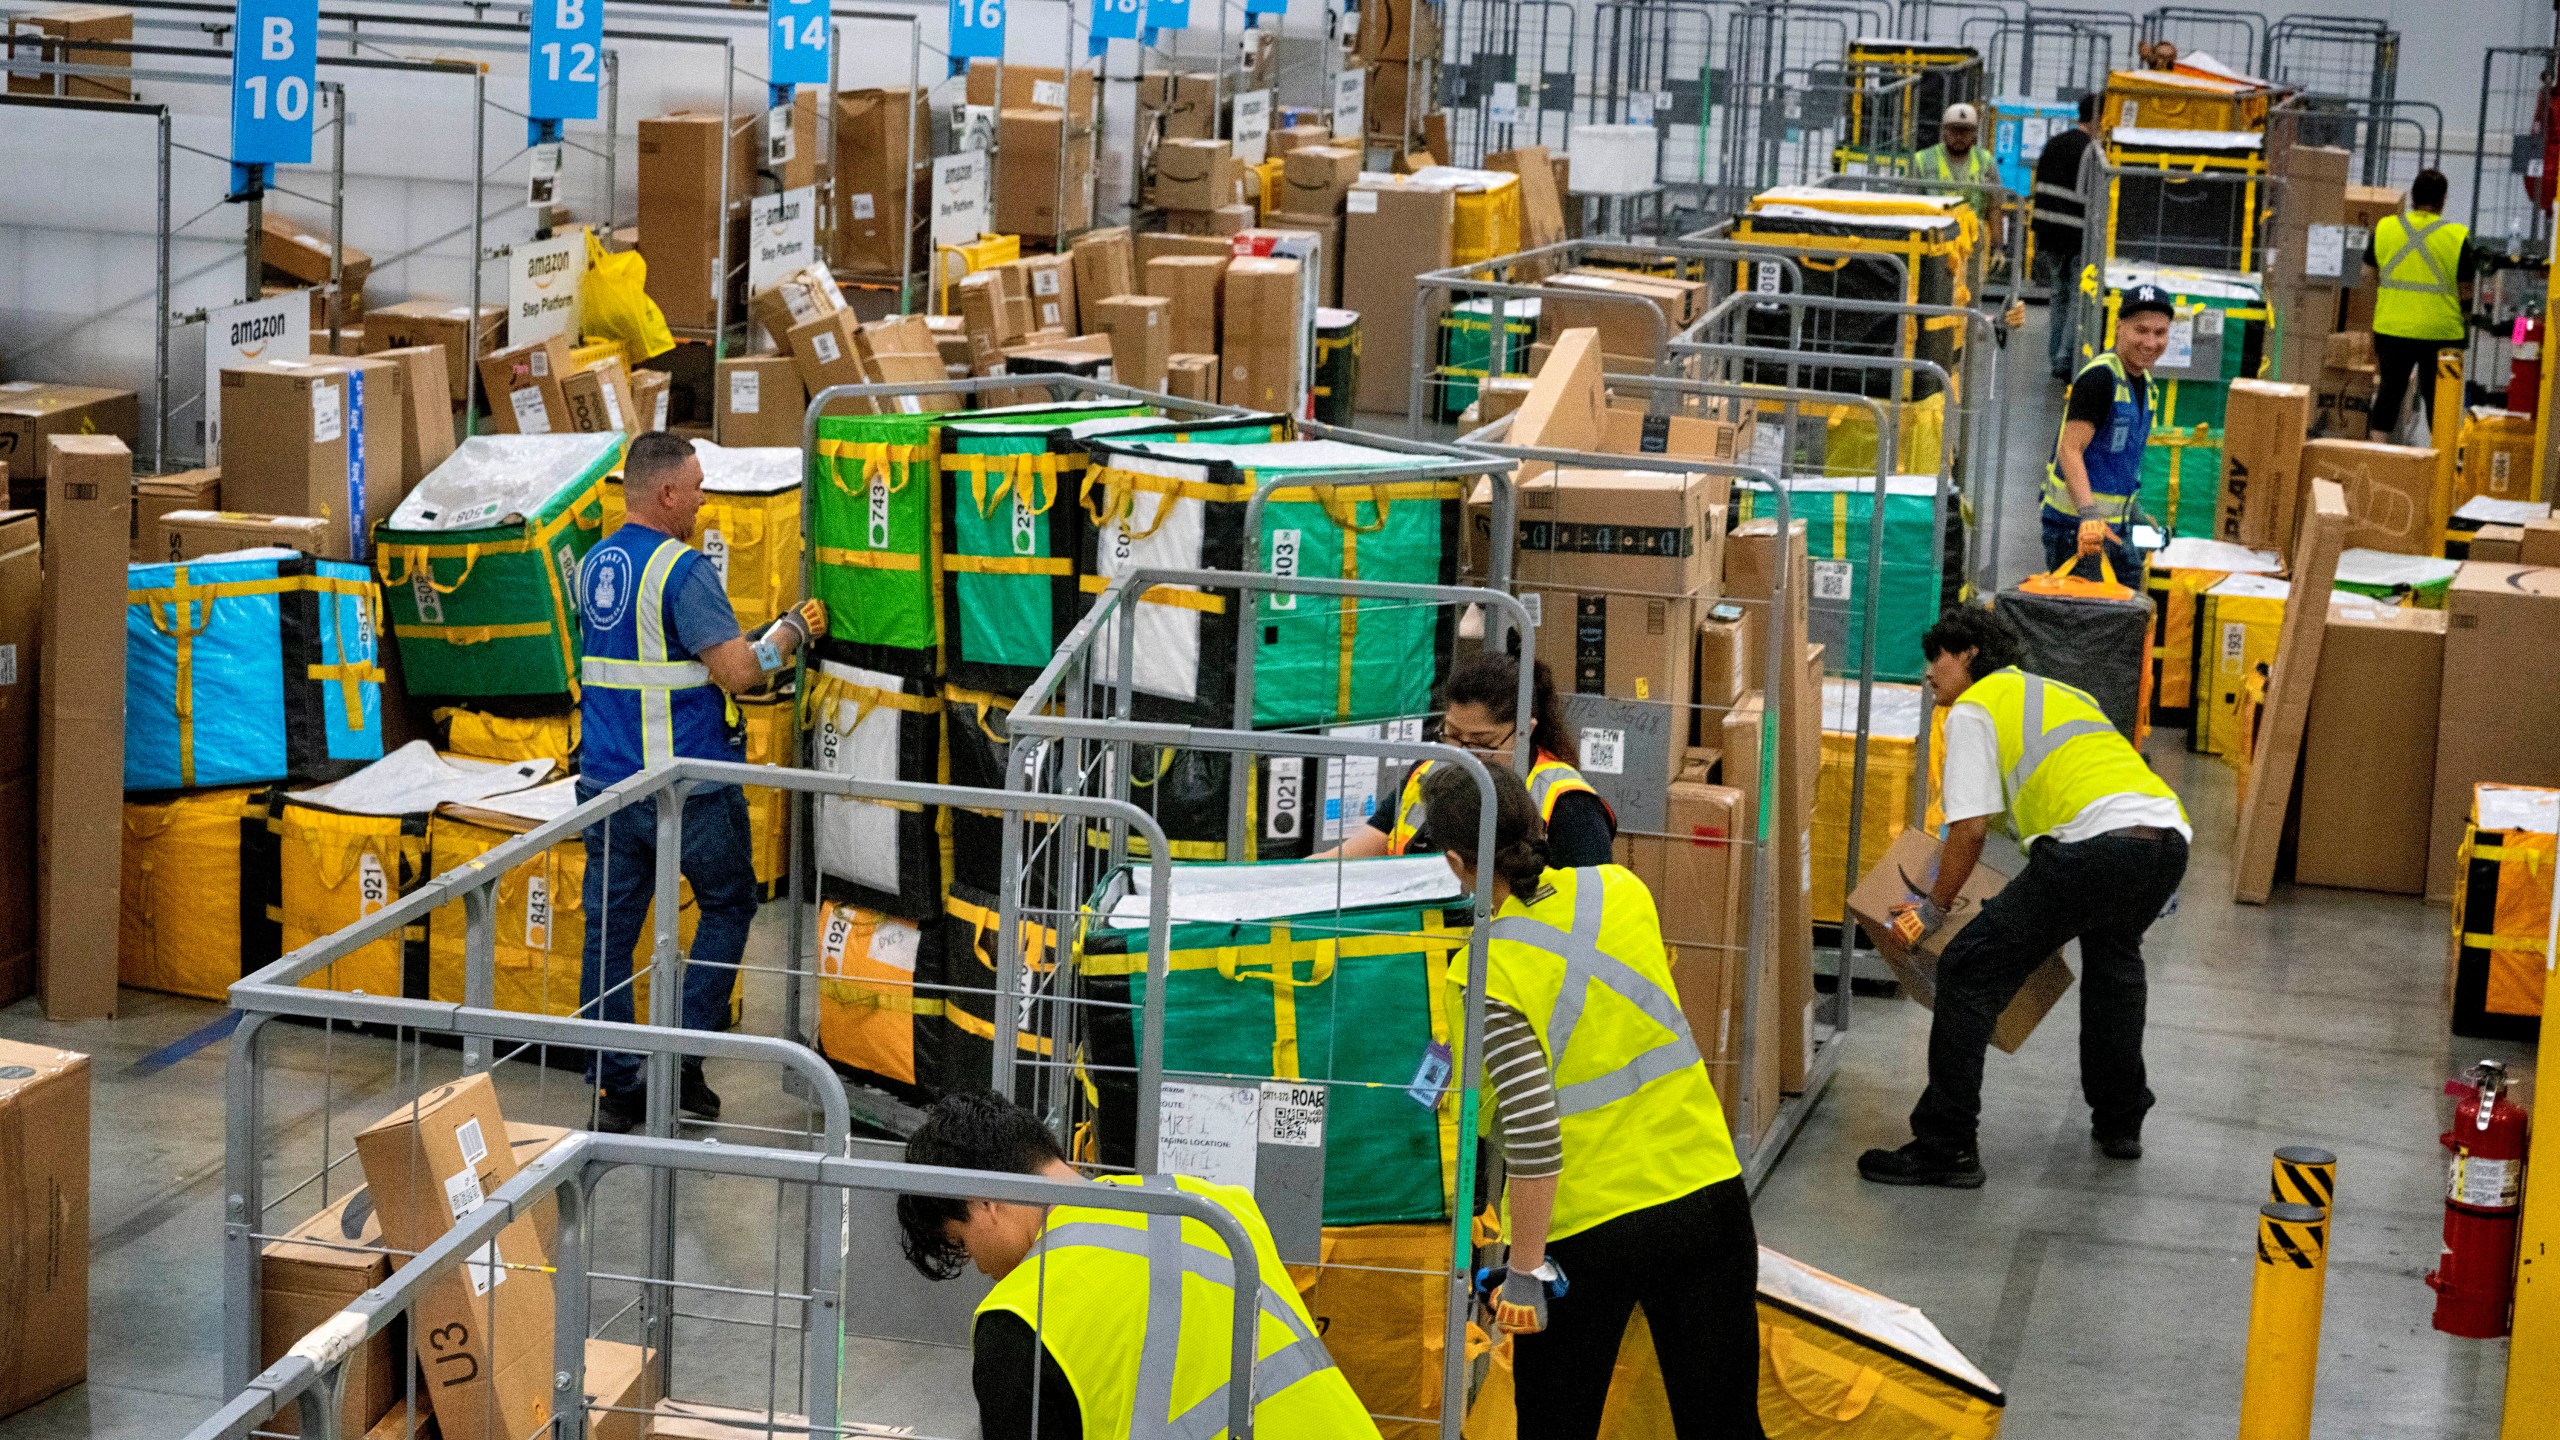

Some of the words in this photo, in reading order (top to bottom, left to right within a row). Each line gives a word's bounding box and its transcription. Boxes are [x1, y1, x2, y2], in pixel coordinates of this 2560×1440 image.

[555, 0, 585, 30] B
[958, 0, 1001, 29] 16
[262, 17, 295, 61] B
[777, 15, 826, 50] 14
[541, 42, 596, 83] 12
[245, 76, 309, 121] 10
[528, 249, 570, 279] amazon
[1761, 265, 1776, 292] 018
[522, 301, 540, 318] Step
[541, 293, 574, 314] Platform
[231, 313, 286, 346] amazon
[872, 485, 885, 522] 743
[2227, 633, 2241, 656] 193
[1277, 775, 1297, 810] 021
[365, 869, 382, 900] 921
[531, 890, 546, 925] 843
[827, 920, 847, 954] 192
[1190, 1138, 1231, 1149] LOCATION:
[429, 1322, 478, 1388] U3
